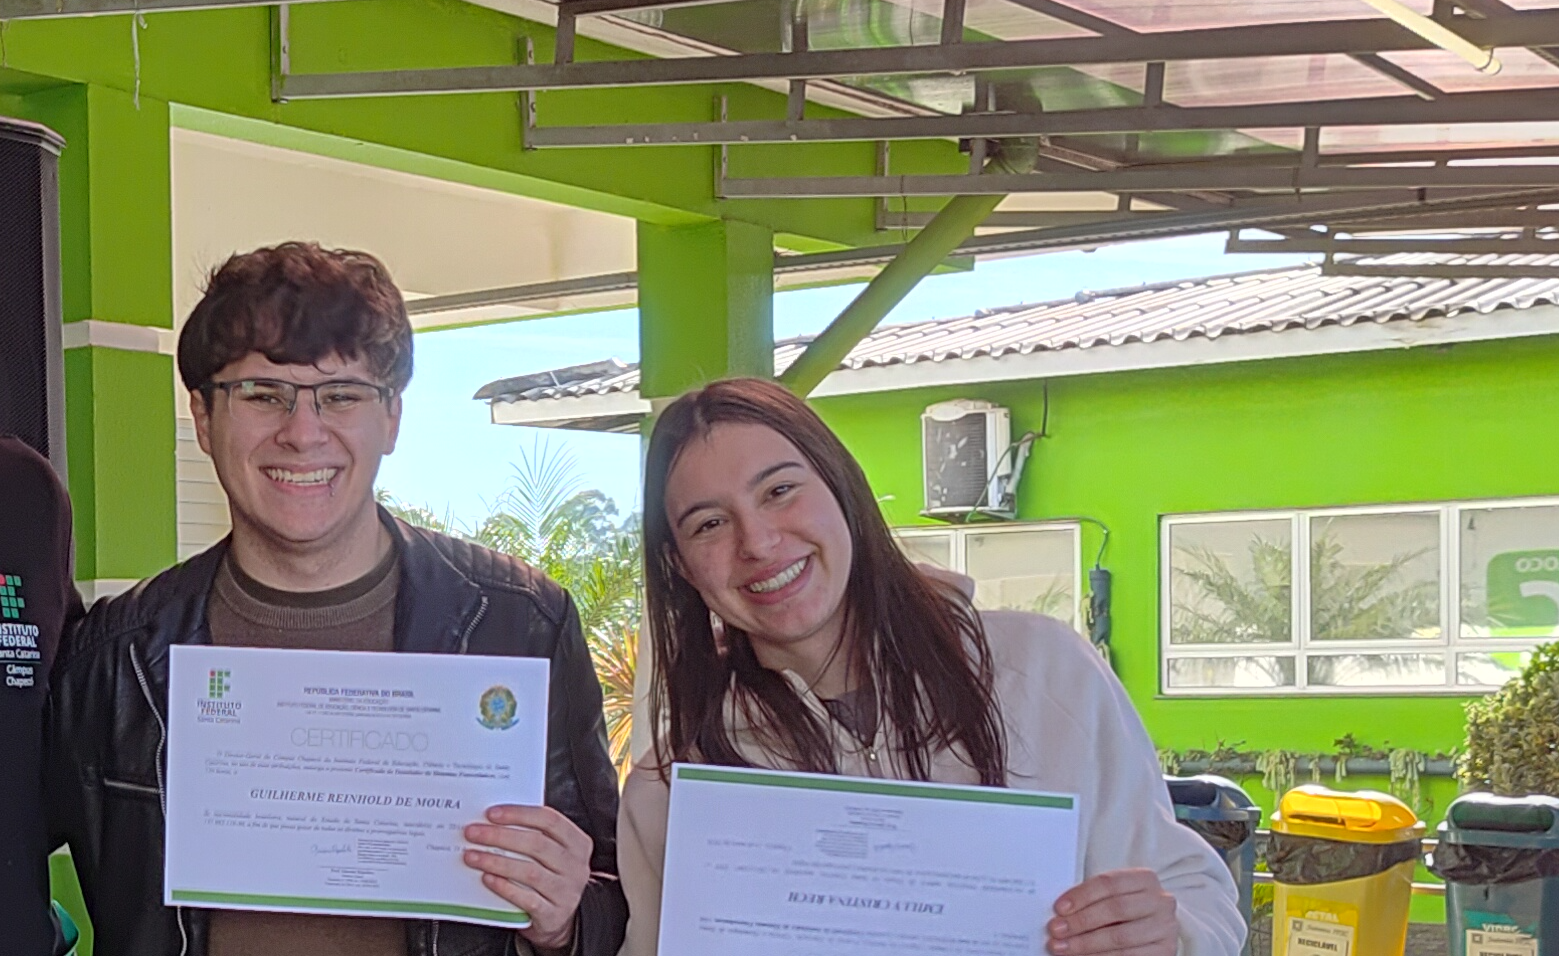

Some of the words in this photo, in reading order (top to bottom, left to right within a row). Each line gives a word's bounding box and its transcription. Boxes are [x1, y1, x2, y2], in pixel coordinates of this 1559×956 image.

[15, 649, 40, 659] Catarina
[197, 700, 241, 709] INSTITUTO
[201, 708, 237, 716] FEDERAL
[291, 727, 428, 752] CERTIFICADO
[250, 788, 325, 802] GUILHERME
[327, 793, 392, 806] REINHOLD
[395, 796, 413, 807] DE
[415, 797, 461, 810] MOURA
[788, 891, 825, 905] RECH
[828, 895, 890, 909] CRISTINA
[894, 901, 944, 915] EMILLY
